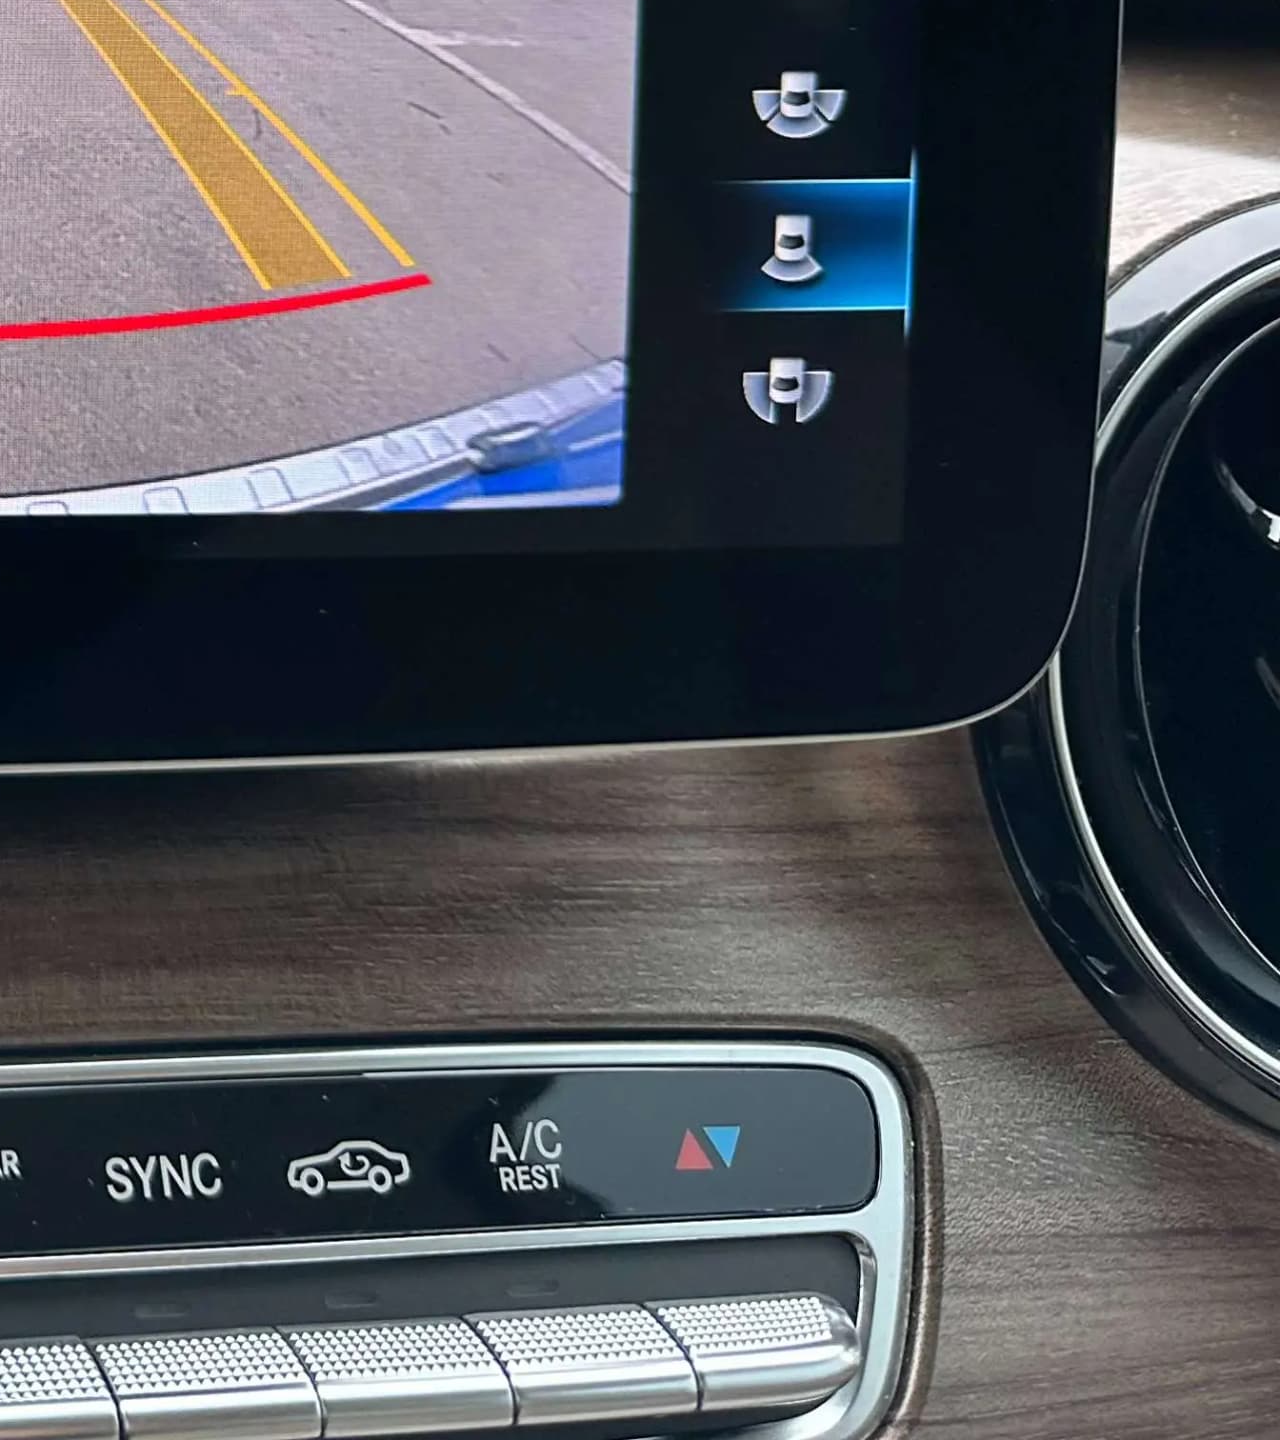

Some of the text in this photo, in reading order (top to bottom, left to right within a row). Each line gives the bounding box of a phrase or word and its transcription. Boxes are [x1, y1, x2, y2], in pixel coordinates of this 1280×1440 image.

[489, 1118, 562, 1163] A/C
[105, 1151, 223, 1201] SYNC
[498, 1163, 561, 1192] REST
